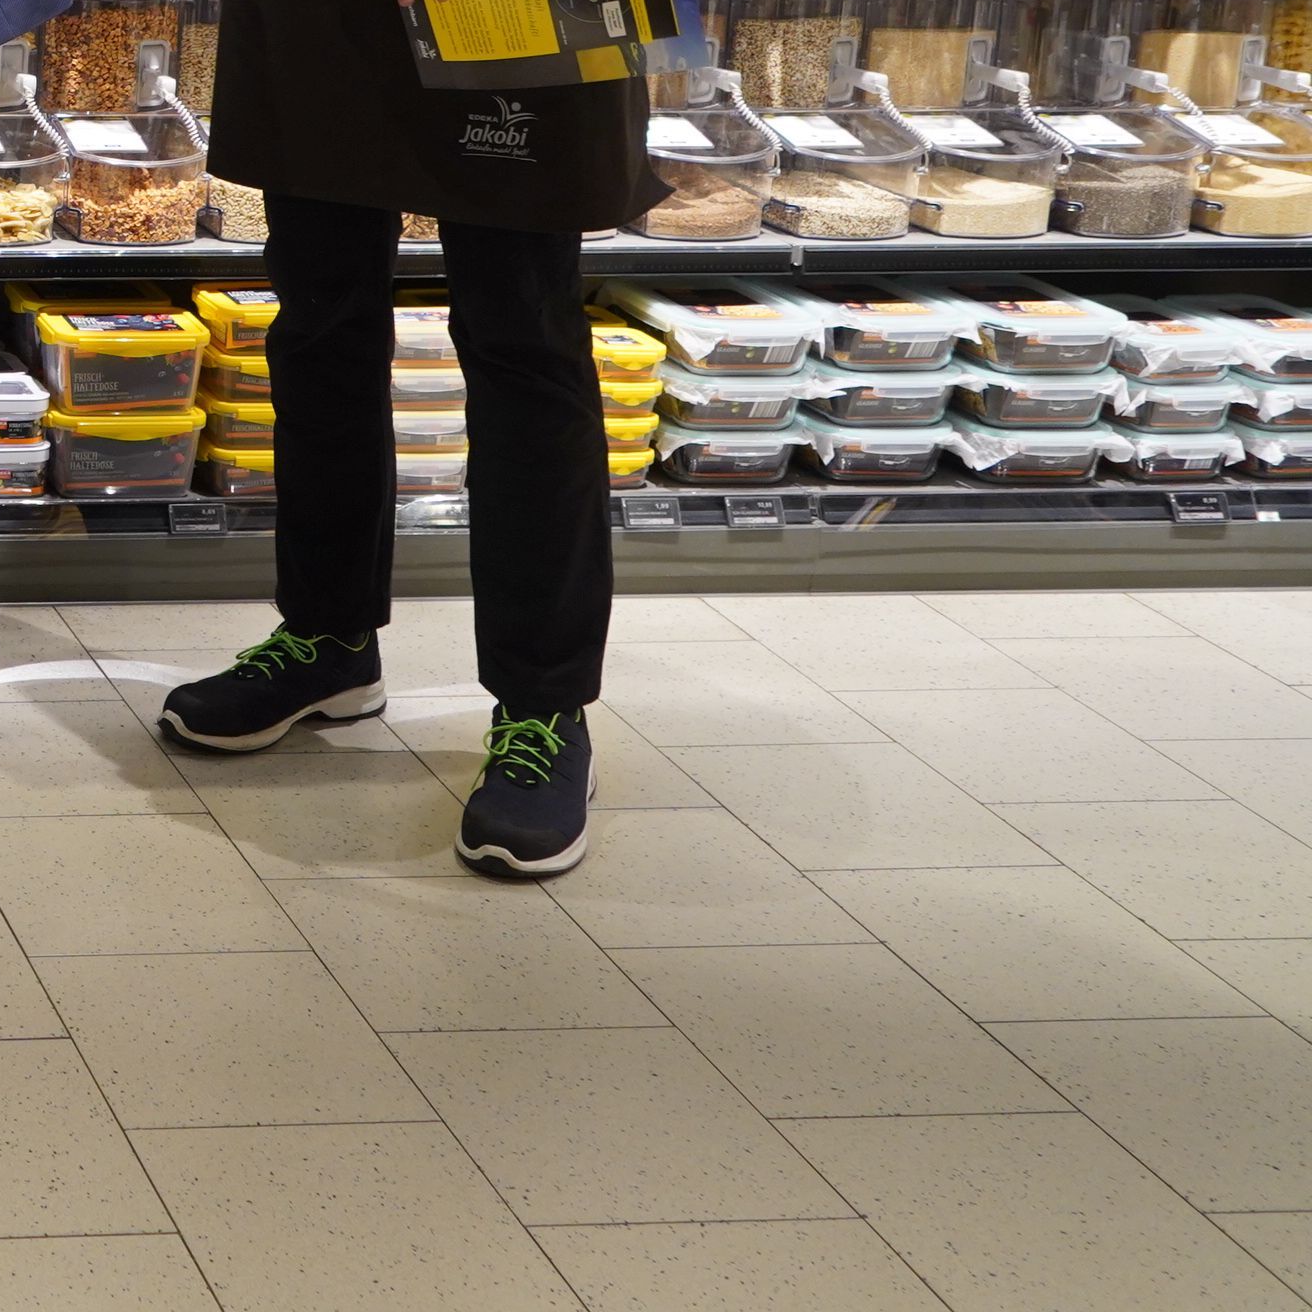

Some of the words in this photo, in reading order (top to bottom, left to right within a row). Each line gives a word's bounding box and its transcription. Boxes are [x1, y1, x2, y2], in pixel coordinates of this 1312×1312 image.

[468, 114, 498, 123] EDEKA
[458, 124, 529, 146] Jakobi
[74, 382, 119, 392] HALTEDOSE
[70, 461, 114, 470] HALTEDOSE
